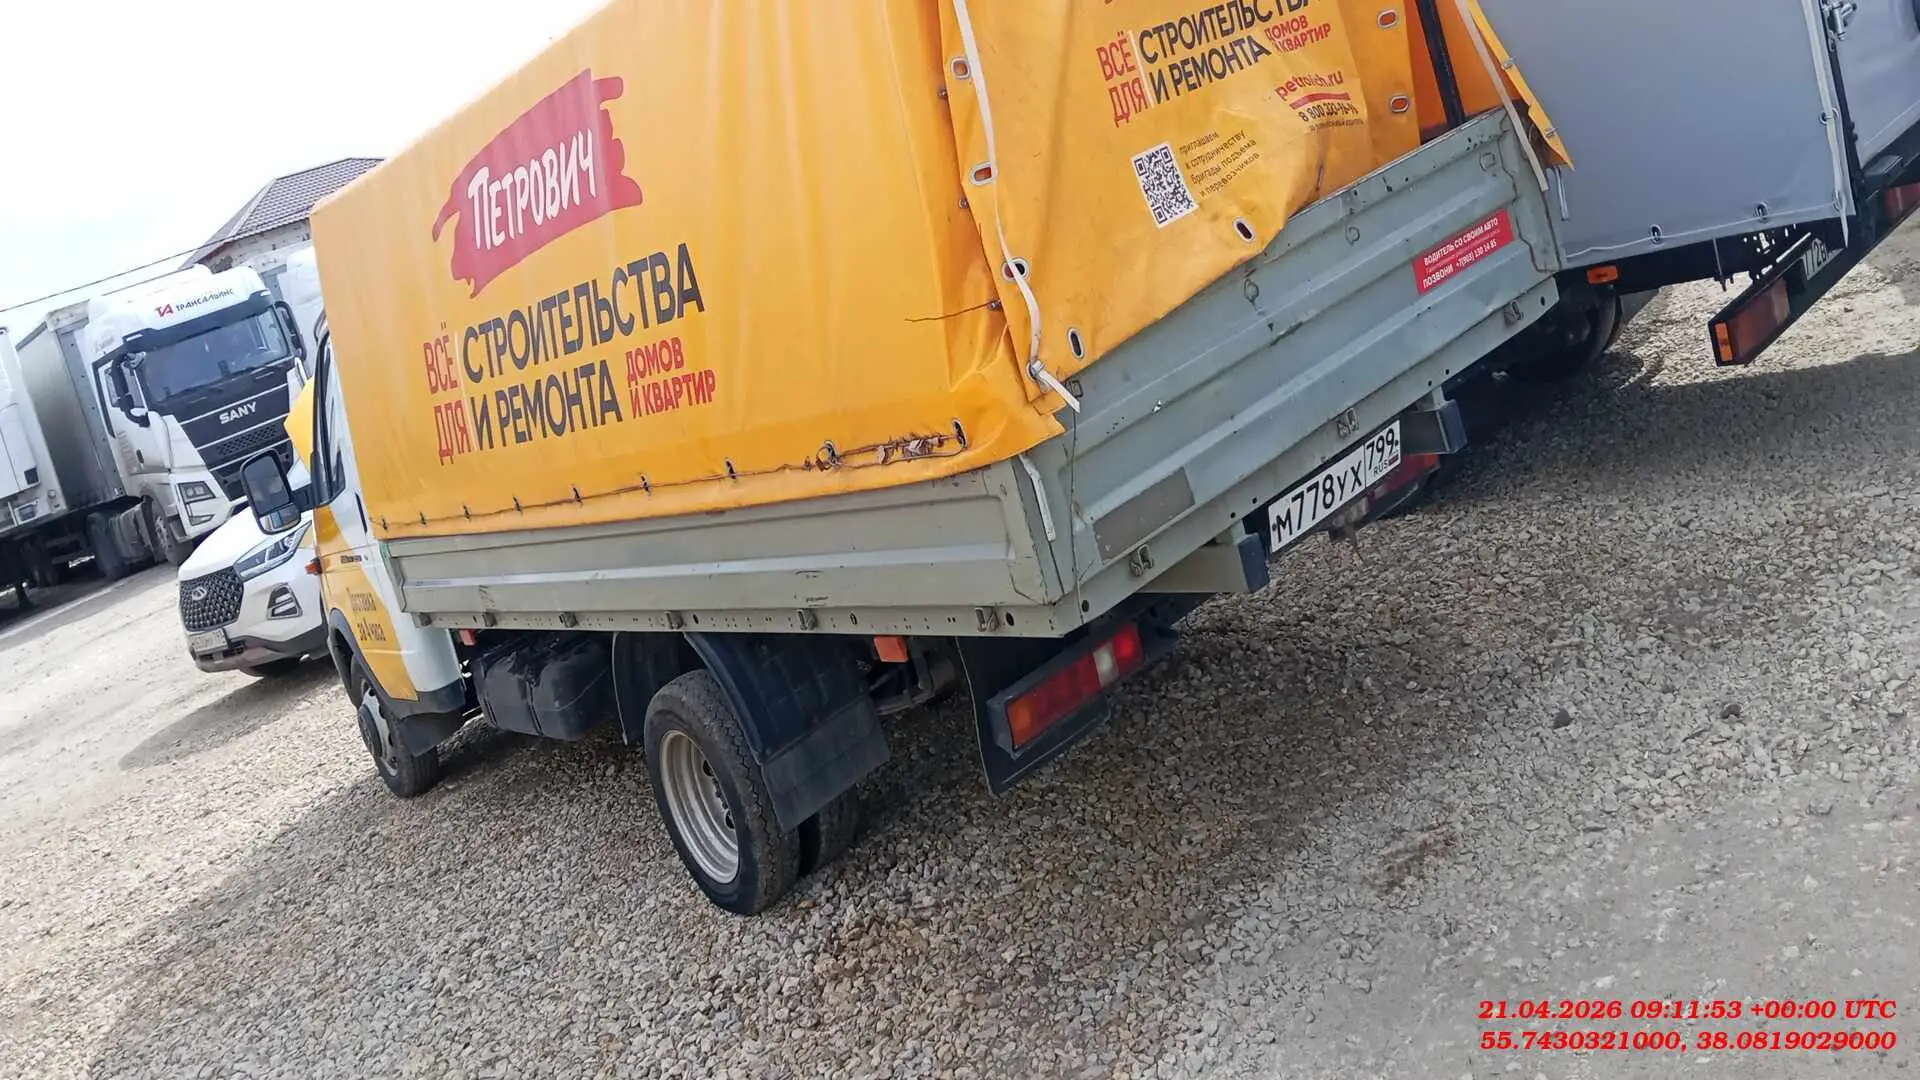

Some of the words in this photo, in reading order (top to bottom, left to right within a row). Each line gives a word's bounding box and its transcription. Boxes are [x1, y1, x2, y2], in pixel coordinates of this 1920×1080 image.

[1096, 31, 1136, 81] ВСЁ
[1138, 0, 1320, 64] СТРОИТЕЛЬСТ
[1149, 69, 1170, 104] И
[1169, 35, 1272, 97] РЕМОНТА
[1108, 77, 1149, 128] ДЛЯ
[1299, 111, 1309, 122] 8
[468, 129, 596, 249] ПЕТРОВИЧ
[1423, 242, 1455, 266] ВОДИТЕЛЬ
[1423, 263, 1454, 289] ПОЗВОНИ
[462, 242, 705, 384] СТРОИТЕЛЬСТВА
[423, 322, 459, 395] ВСЁ
[625, 336, 685, 388] ДОМОВ
[219, 401, 256, 424] SANY
[470, 394, 494, 452] И
[495, 359, 623, 447] РЕМОНТА
[629, 385, 642, 419] И
[641, 369, 717, 418] КВАРТИР
[433, 400, 472, 466] ДЛЯ
[1366, 428, 1395, 471] 799
[1373, 460, 1389, 477] RUS
